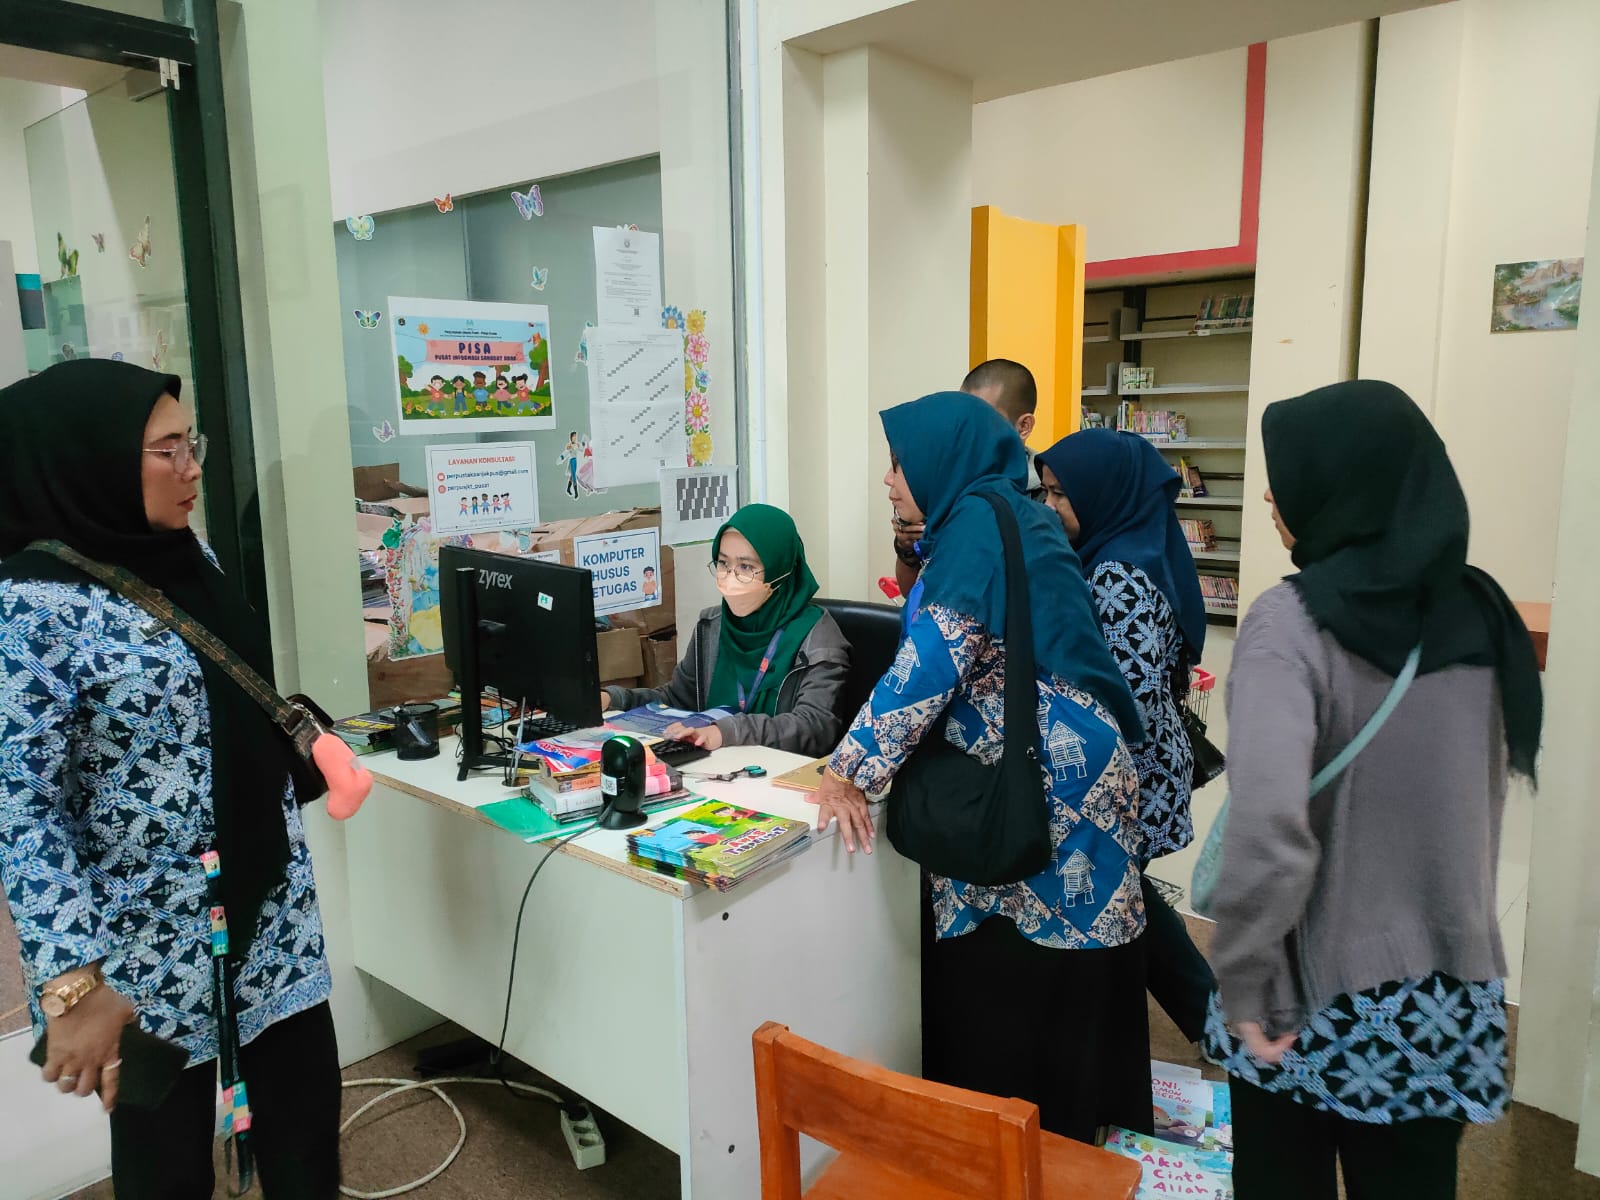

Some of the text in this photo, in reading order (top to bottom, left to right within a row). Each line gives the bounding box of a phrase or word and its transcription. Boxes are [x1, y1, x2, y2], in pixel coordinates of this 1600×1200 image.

[458, 342, 491, 354] PISA
[448, 457, 478, 465] LAYANAN
[583, 547, 645, 567] KOMPUTER
[478, 569, 513, 590] zyrex
[592, 565, 630, 581] HUSUS
[593, 580, 637, 598] ETUGAS
[1153, 1169, 1204, 1182] Cinta
[1153, 1181, 1209, 1194] Allah
